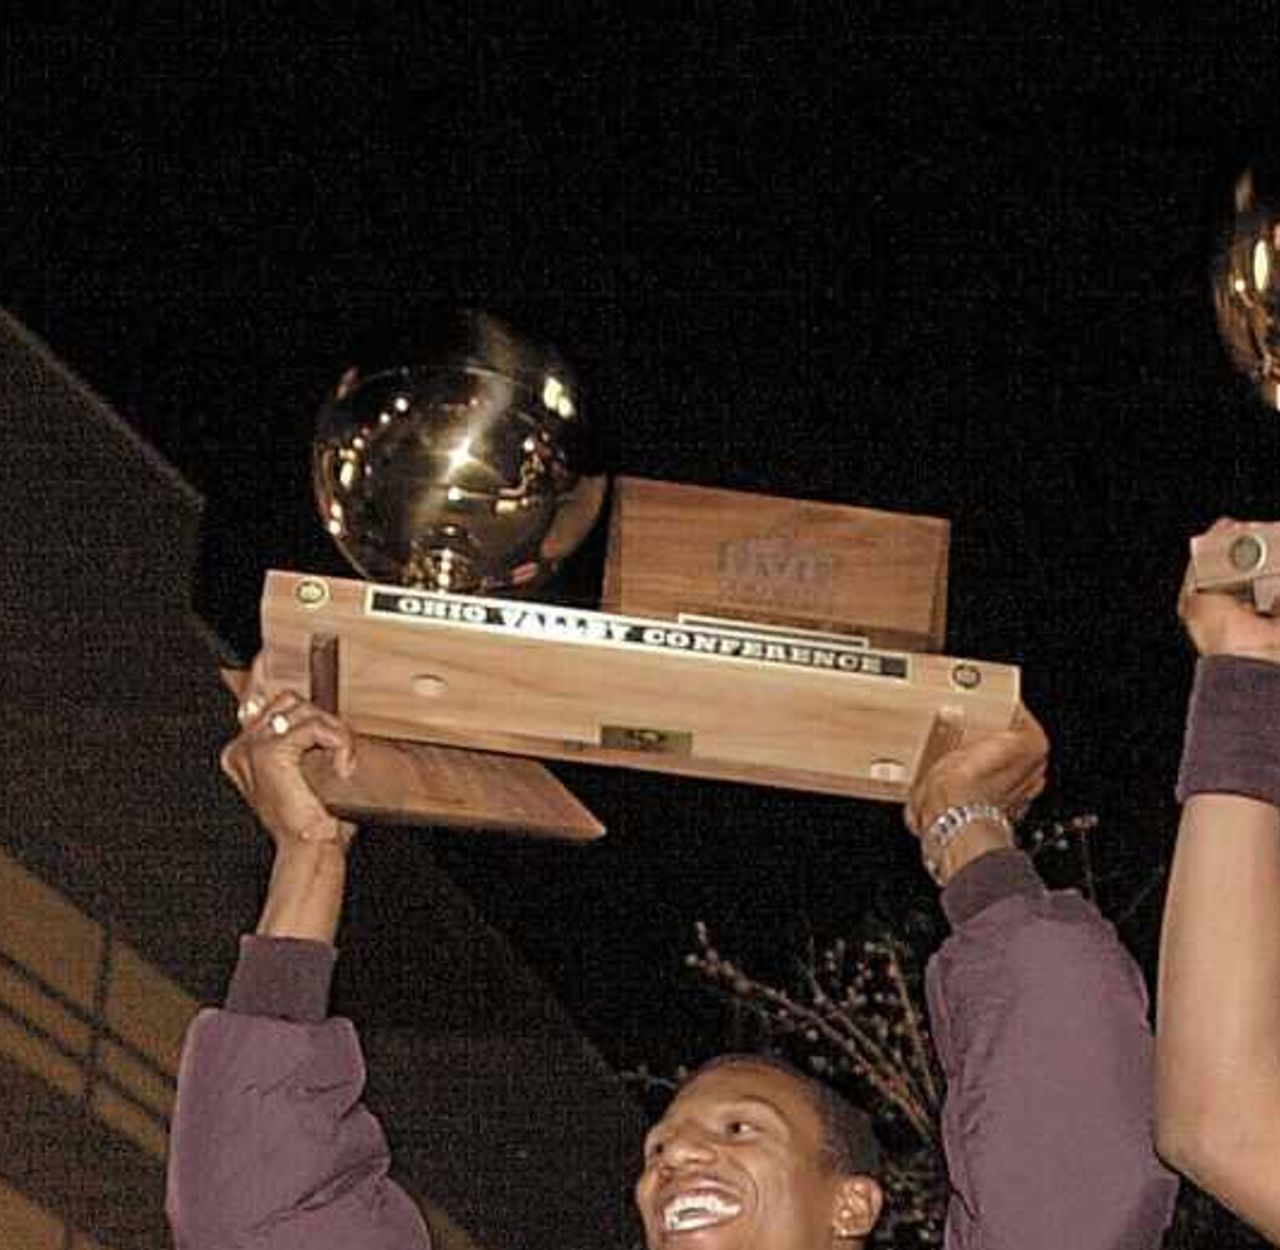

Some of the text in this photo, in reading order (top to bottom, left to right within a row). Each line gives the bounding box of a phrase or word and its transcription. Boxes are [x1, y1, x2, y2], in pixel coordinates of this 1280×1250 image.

[397, 596, 882, 673] OHIO VALLEY CONFERENCE
